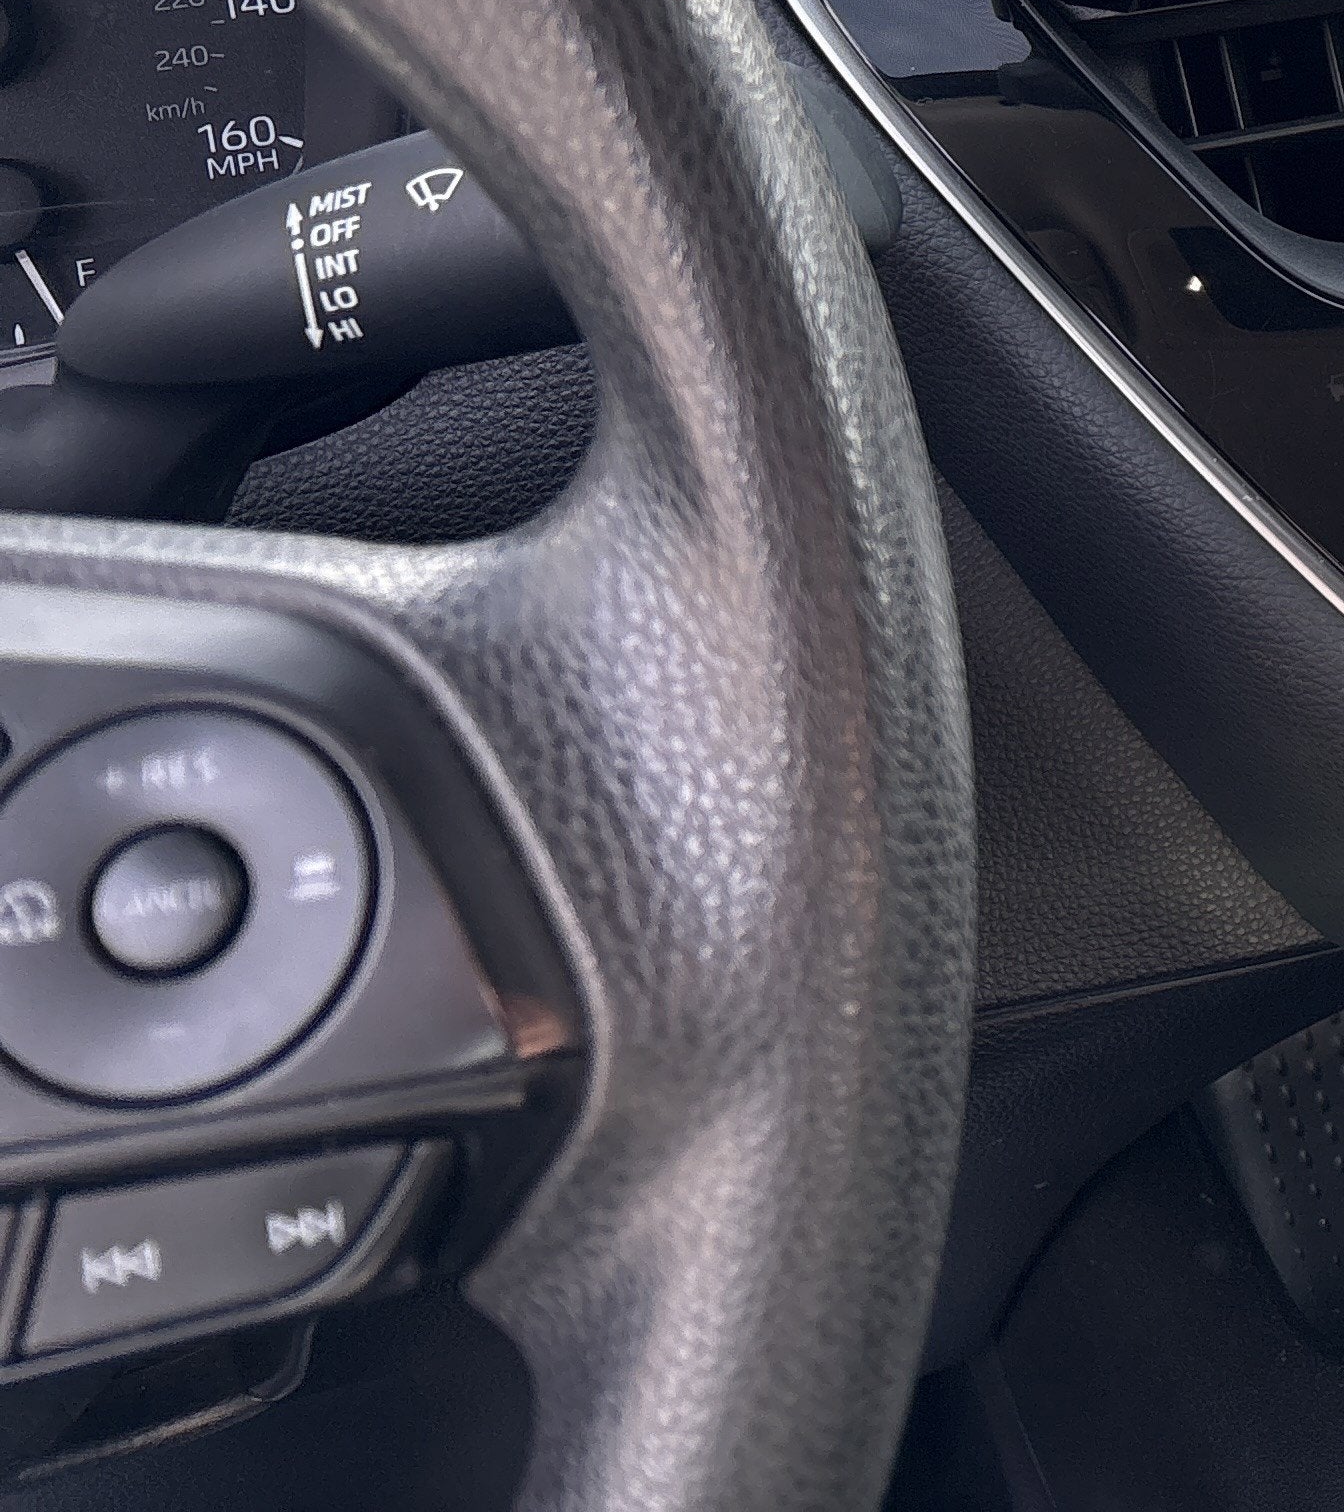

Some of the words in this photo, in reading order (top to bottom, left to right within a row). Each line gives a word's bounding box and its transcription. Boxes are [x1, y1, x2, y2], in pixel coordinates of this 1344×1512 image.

[155, 45, 208, 71] 240
[146, 97, 205, 122] km/h
[198, 116, 276, 153] 160
[206, 149, 279, 179] MPH
[309, 182, 371, 216] MIST
[310, 216, 360, 247] OFF
[76, 258, 95, 286] F
[316, 250, 358, 280] INT
[320, 286, 357, 312] LO
[328, 319, 364, 341] HI
